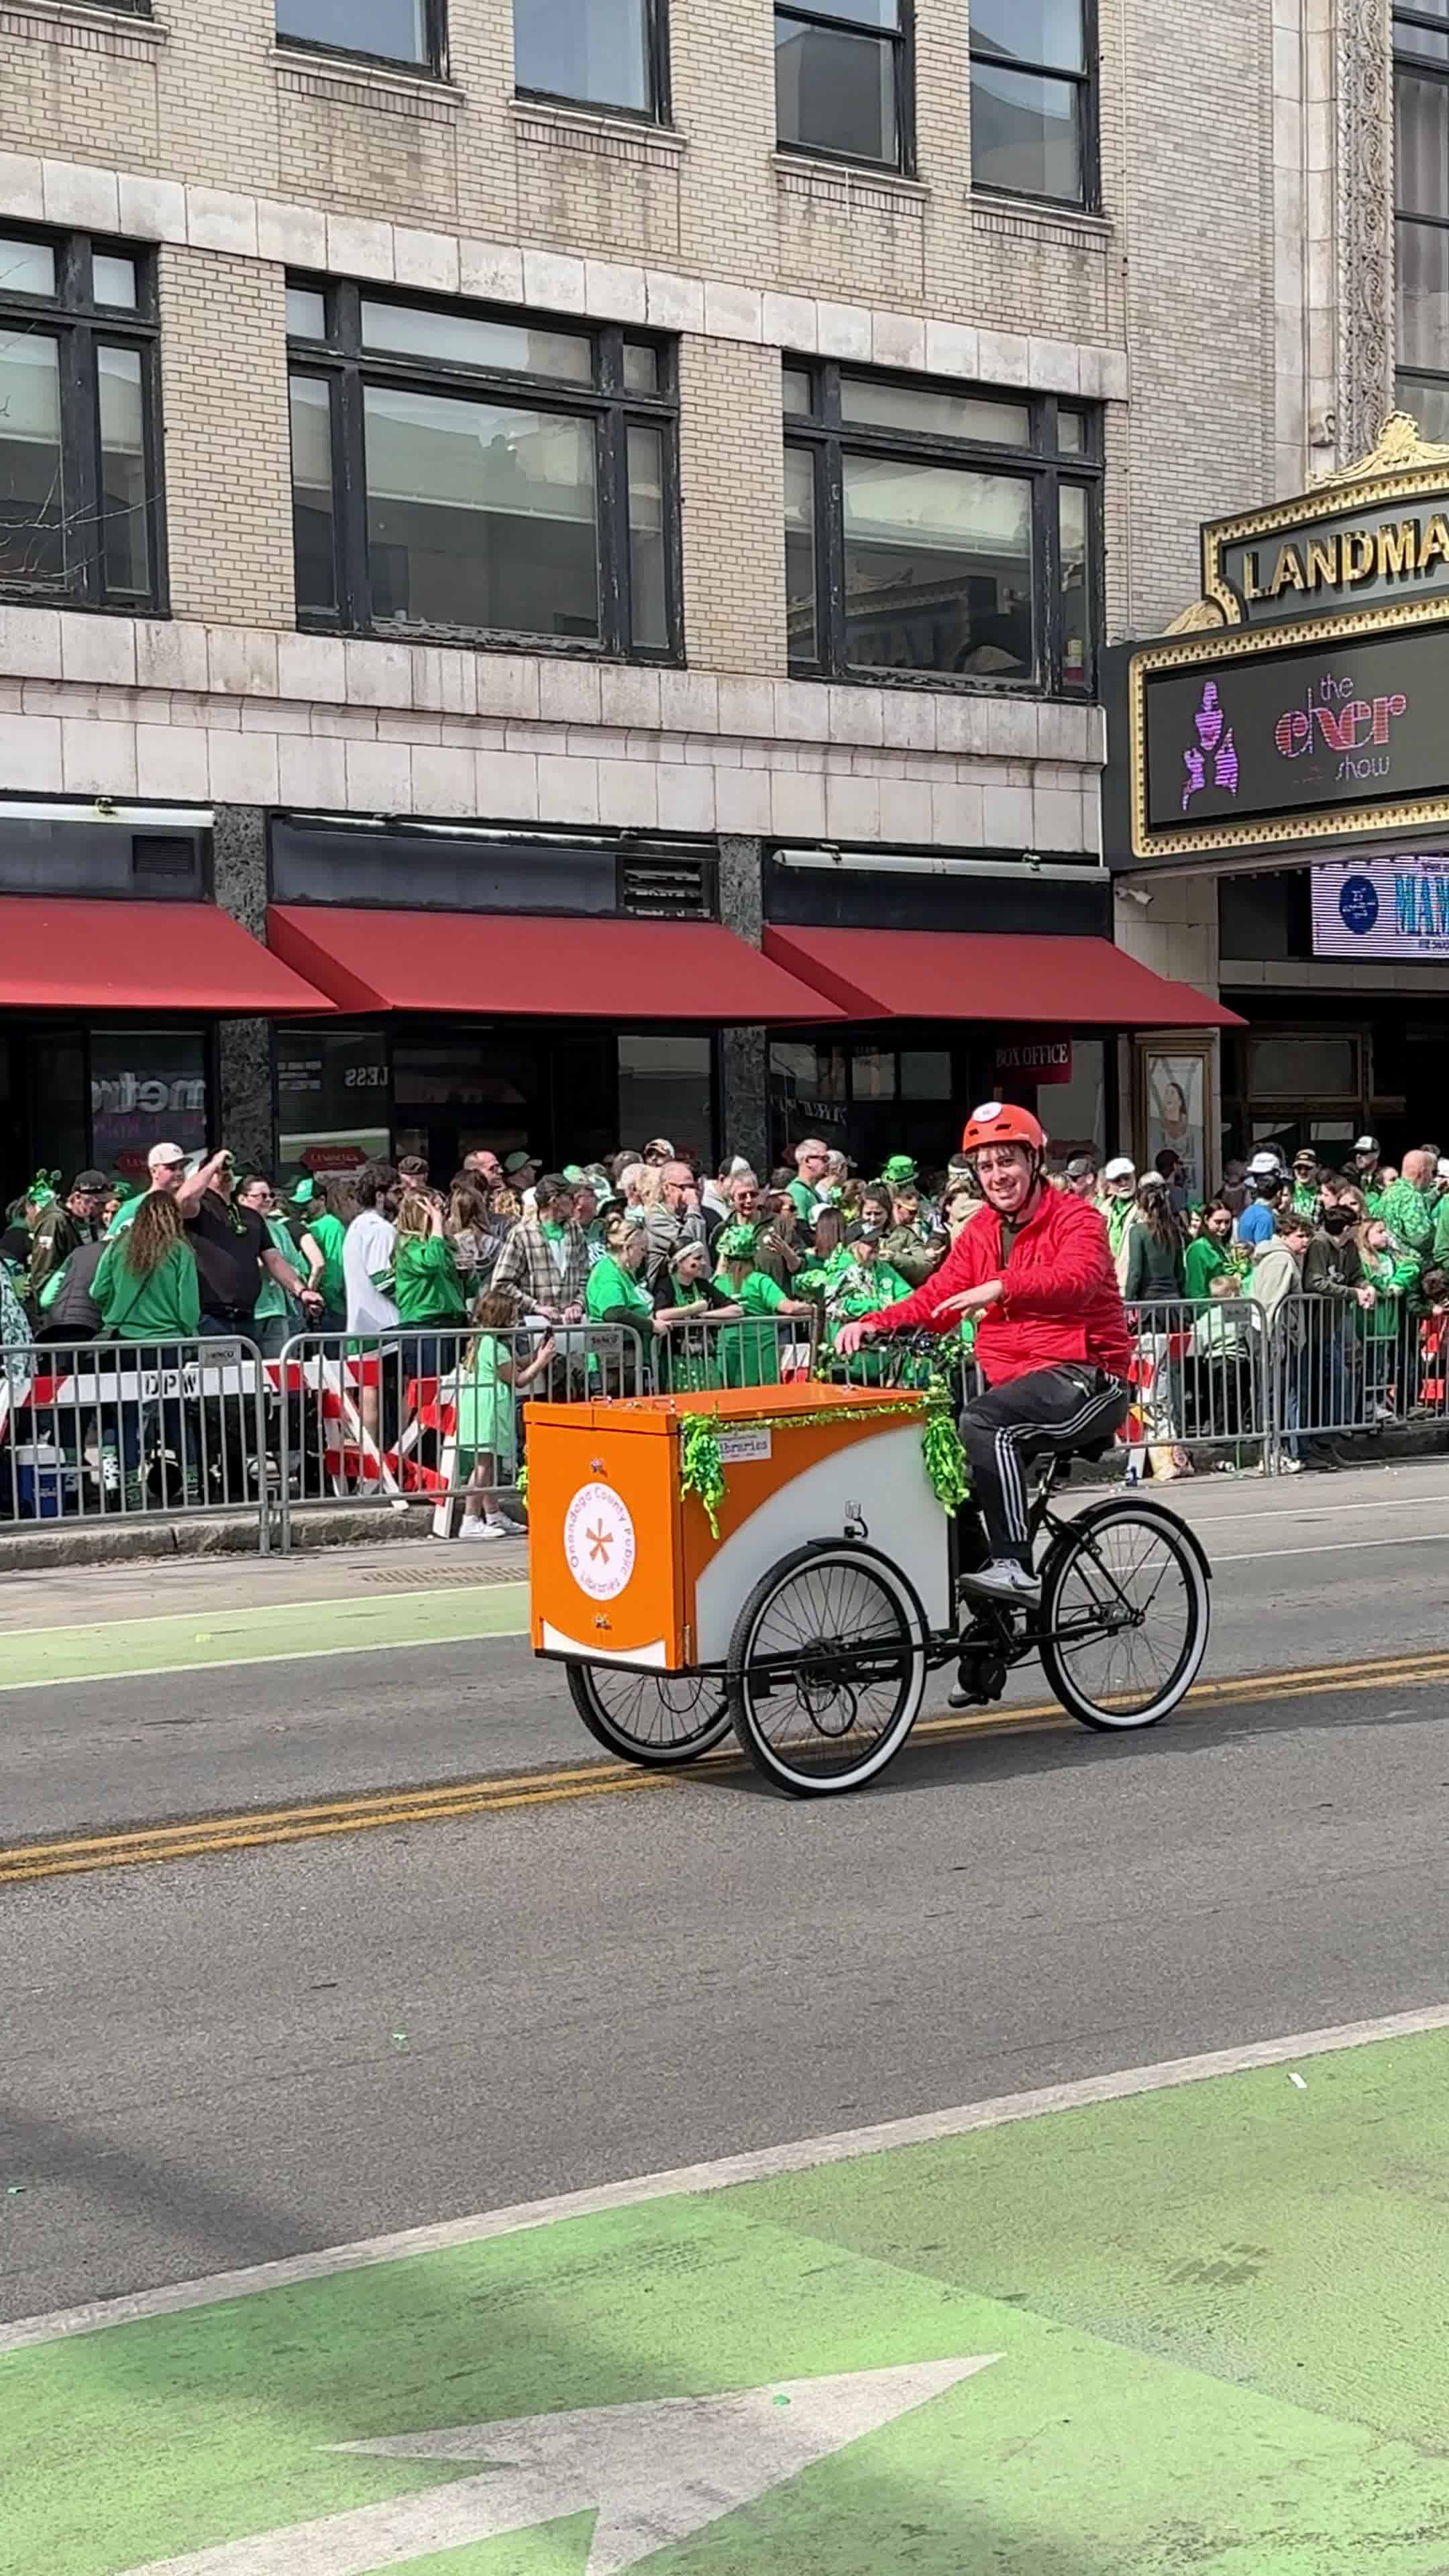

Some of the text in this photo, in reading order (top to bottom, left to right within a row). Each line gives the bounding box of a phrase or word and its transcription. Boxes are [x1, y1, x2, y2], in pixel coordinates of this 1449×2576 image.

[1244, 514, 1449, 600] LANDMA
[1320, 673, 1354, 700] the
[1335, 753, 1390, 782] show
[996, 1043, 1069, 1068] BOX OFFICE
[146, 1373, 197, 1395] DPW
[719, 1440, 768, 1454] ibraries
[594, 1486, 626, 1521] County
